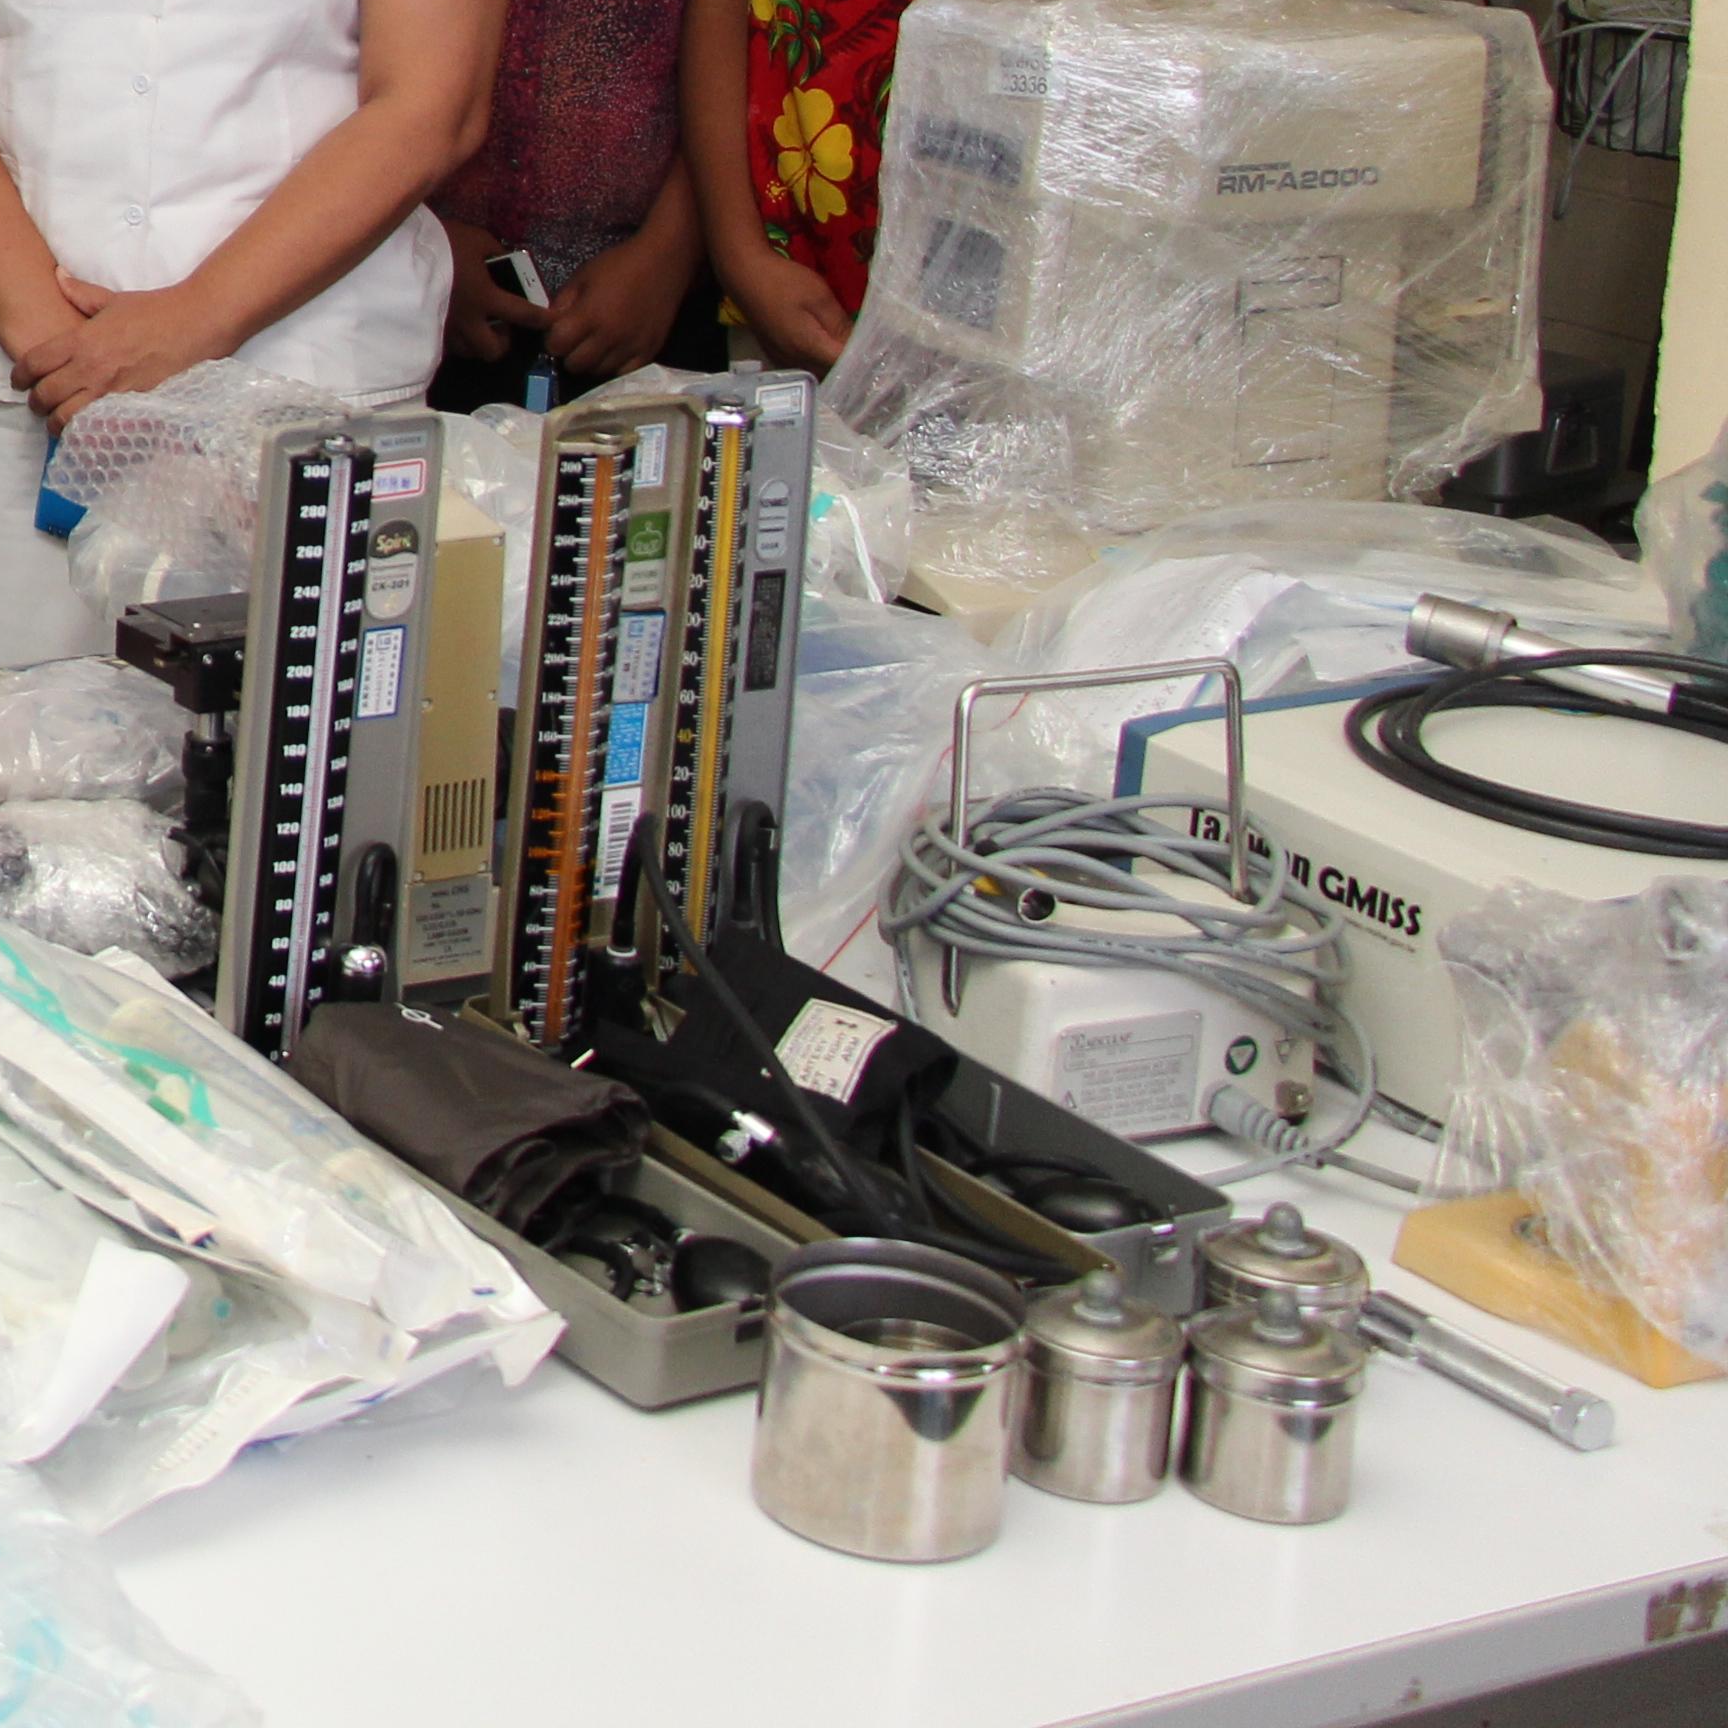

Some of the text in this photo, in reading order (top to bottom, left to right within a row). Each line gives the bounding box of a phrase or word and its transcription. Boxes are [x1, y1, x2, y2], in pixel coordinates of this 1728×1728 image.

[1217, 166, 1379, 196] RM-A2000
[303, 465, 330, 478] 300
[300, 505, 327, 519] 280
[296, 545, 323, 559] 260
[293, 585, 320, 599] 240
[290, 625, 317, 639] 220
[286, 665, 313, 679] 200
[286, 705, 310, 718] 180
[283, 744, 307, 757] 160
[280, 783, 303, 796] 140
[277, 822, 300, 835] 120
[273, 860, 296, 873] 100
[1189, 804, 1311, 887] Tawn
[1318, 865, 1422, 937] GMISS
[275, 898, 293, 911] 80
[316, 911, 330, 925] 70
[271, 937, 290, 950] 60
[268, 975, 286, 987] 40
[264, 1013, 282, 1025] 20
